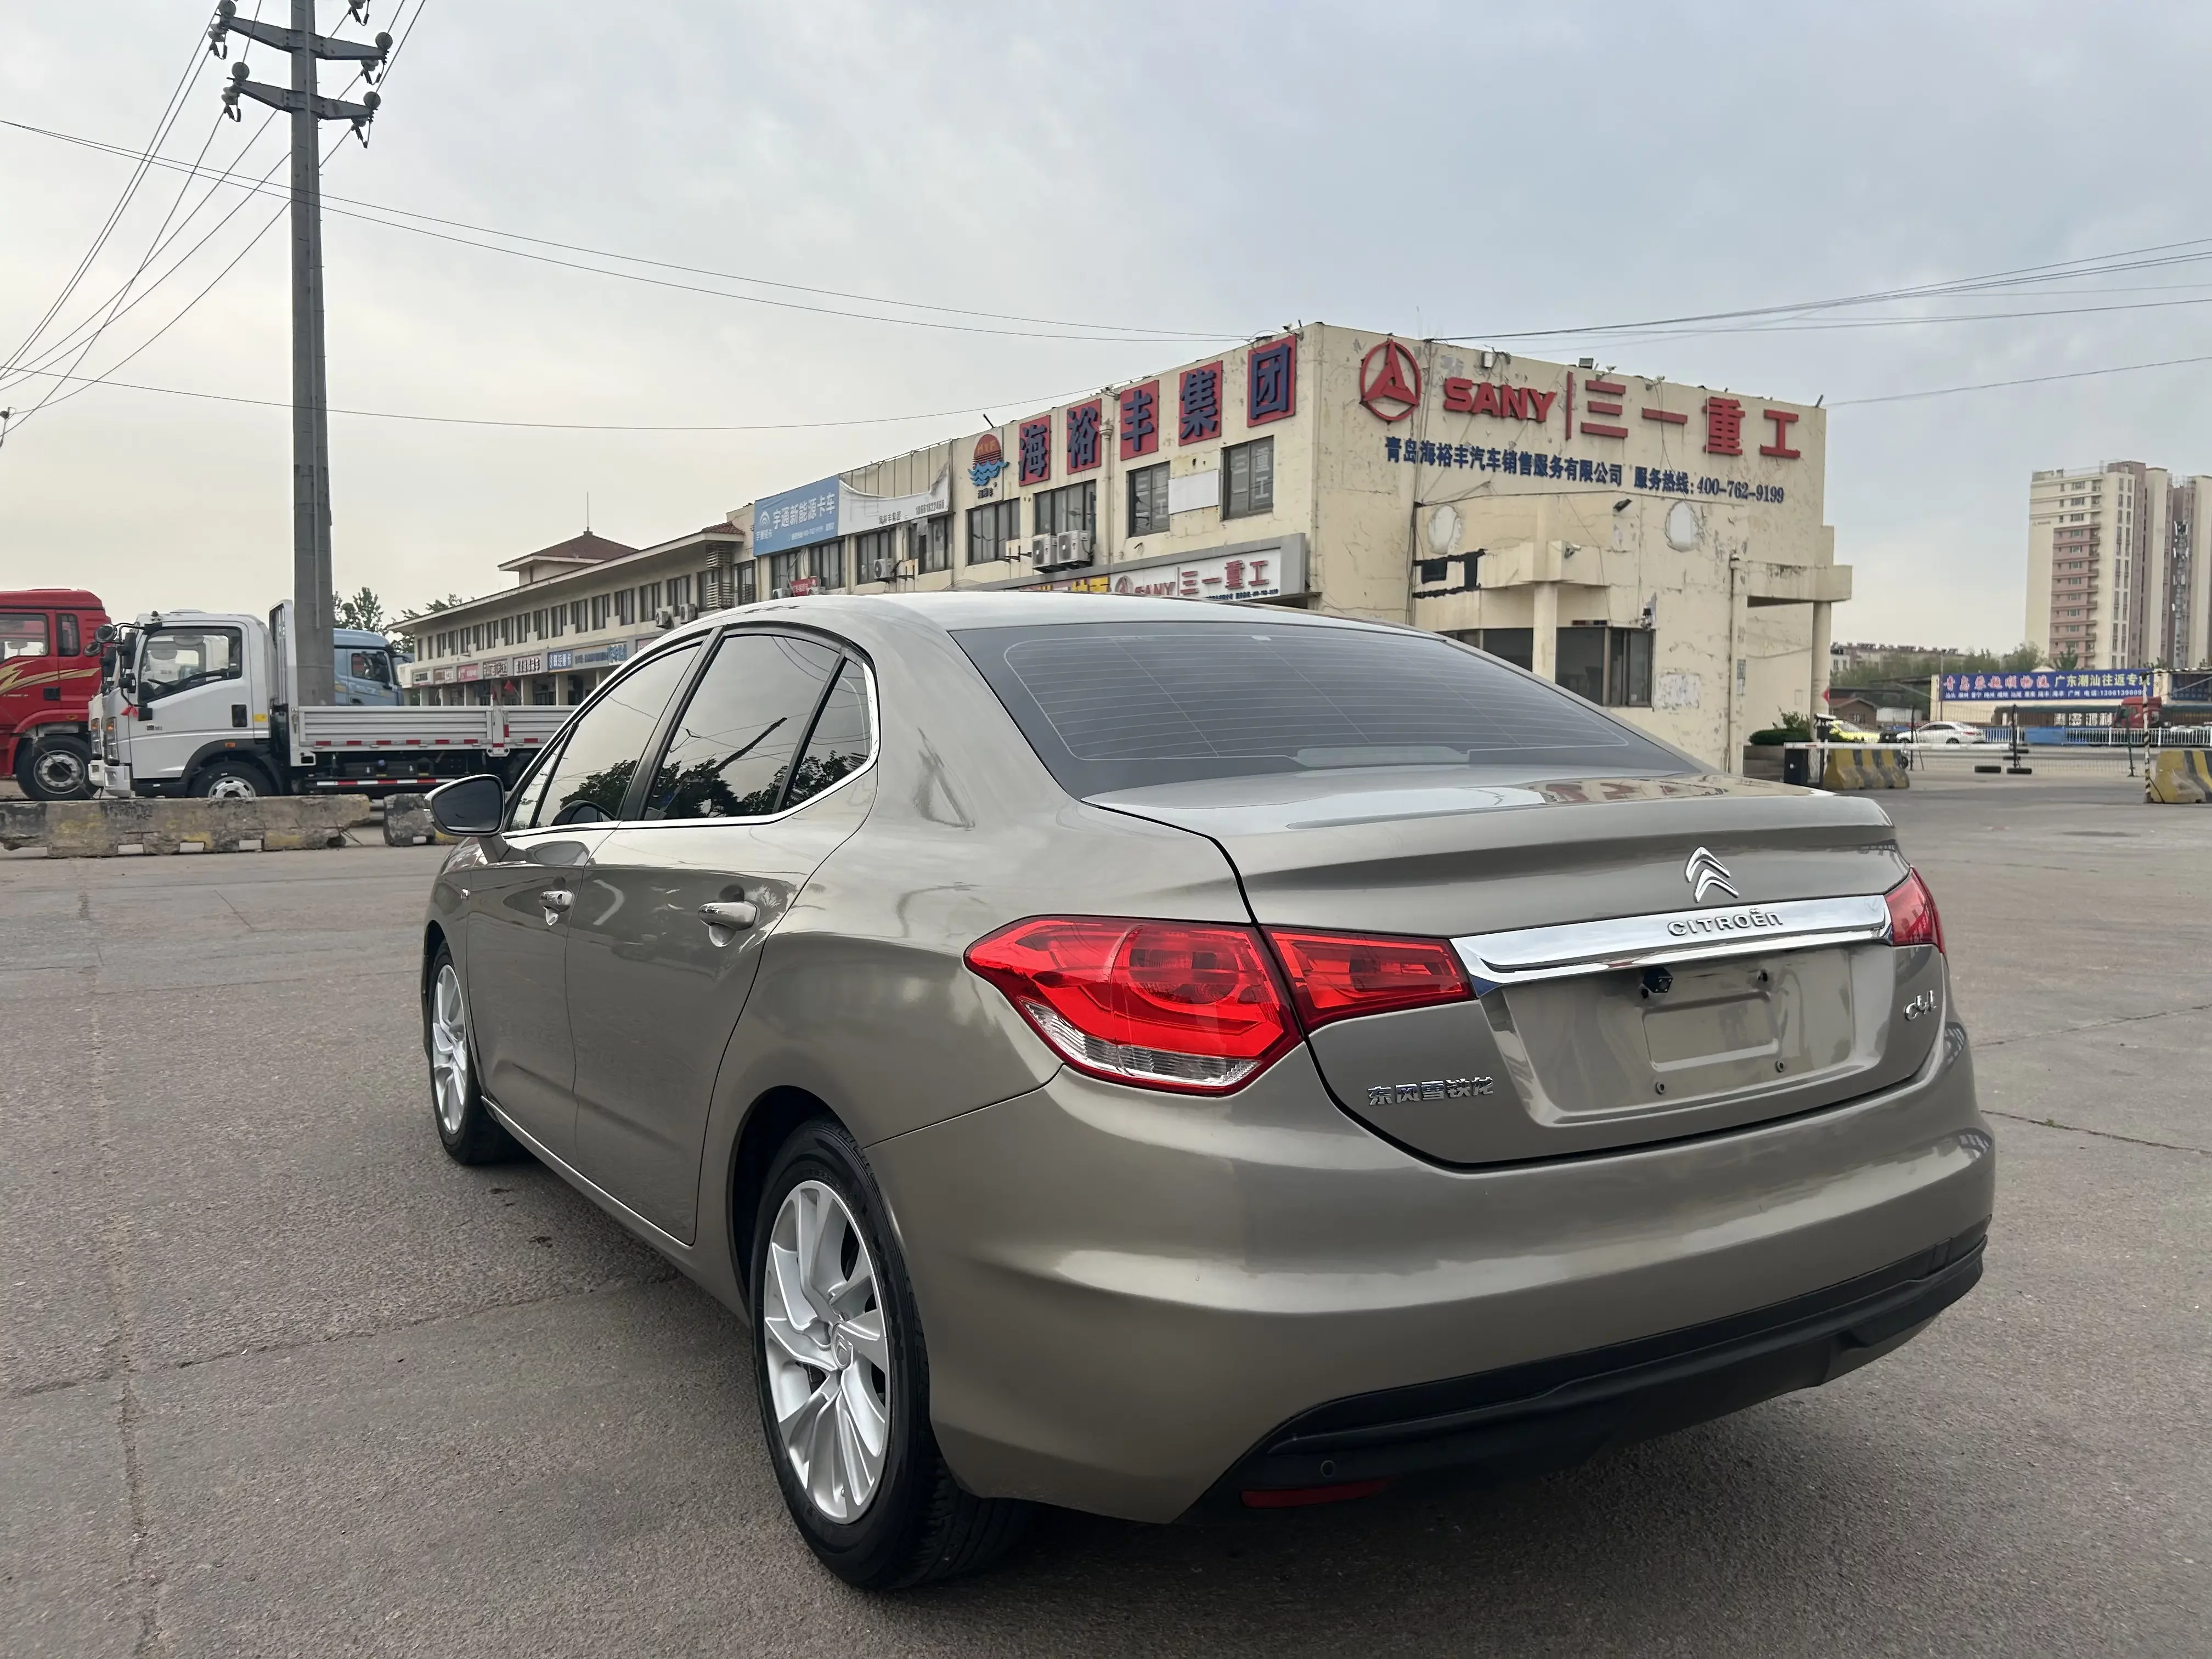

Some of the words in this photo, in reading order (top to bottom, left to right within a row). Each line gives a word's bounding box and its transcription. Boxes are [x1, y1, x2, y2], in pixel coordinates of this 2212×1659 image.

[1019, 343, 1291, 481] 海裕丰集团
[1444, 377, 1556, 422] SANY
[1581, 379, 1801, 459] 三一重工
[1385, 437, 1623, 487] 青岛海裕丰汽车销售服务有限公司
[772, 492, 836, 529] 宇通新能源卡车
[1180, 560, 1269, 596] 三一重工
[1367, 1076, 1494, 1106] 东风雪铁龙
